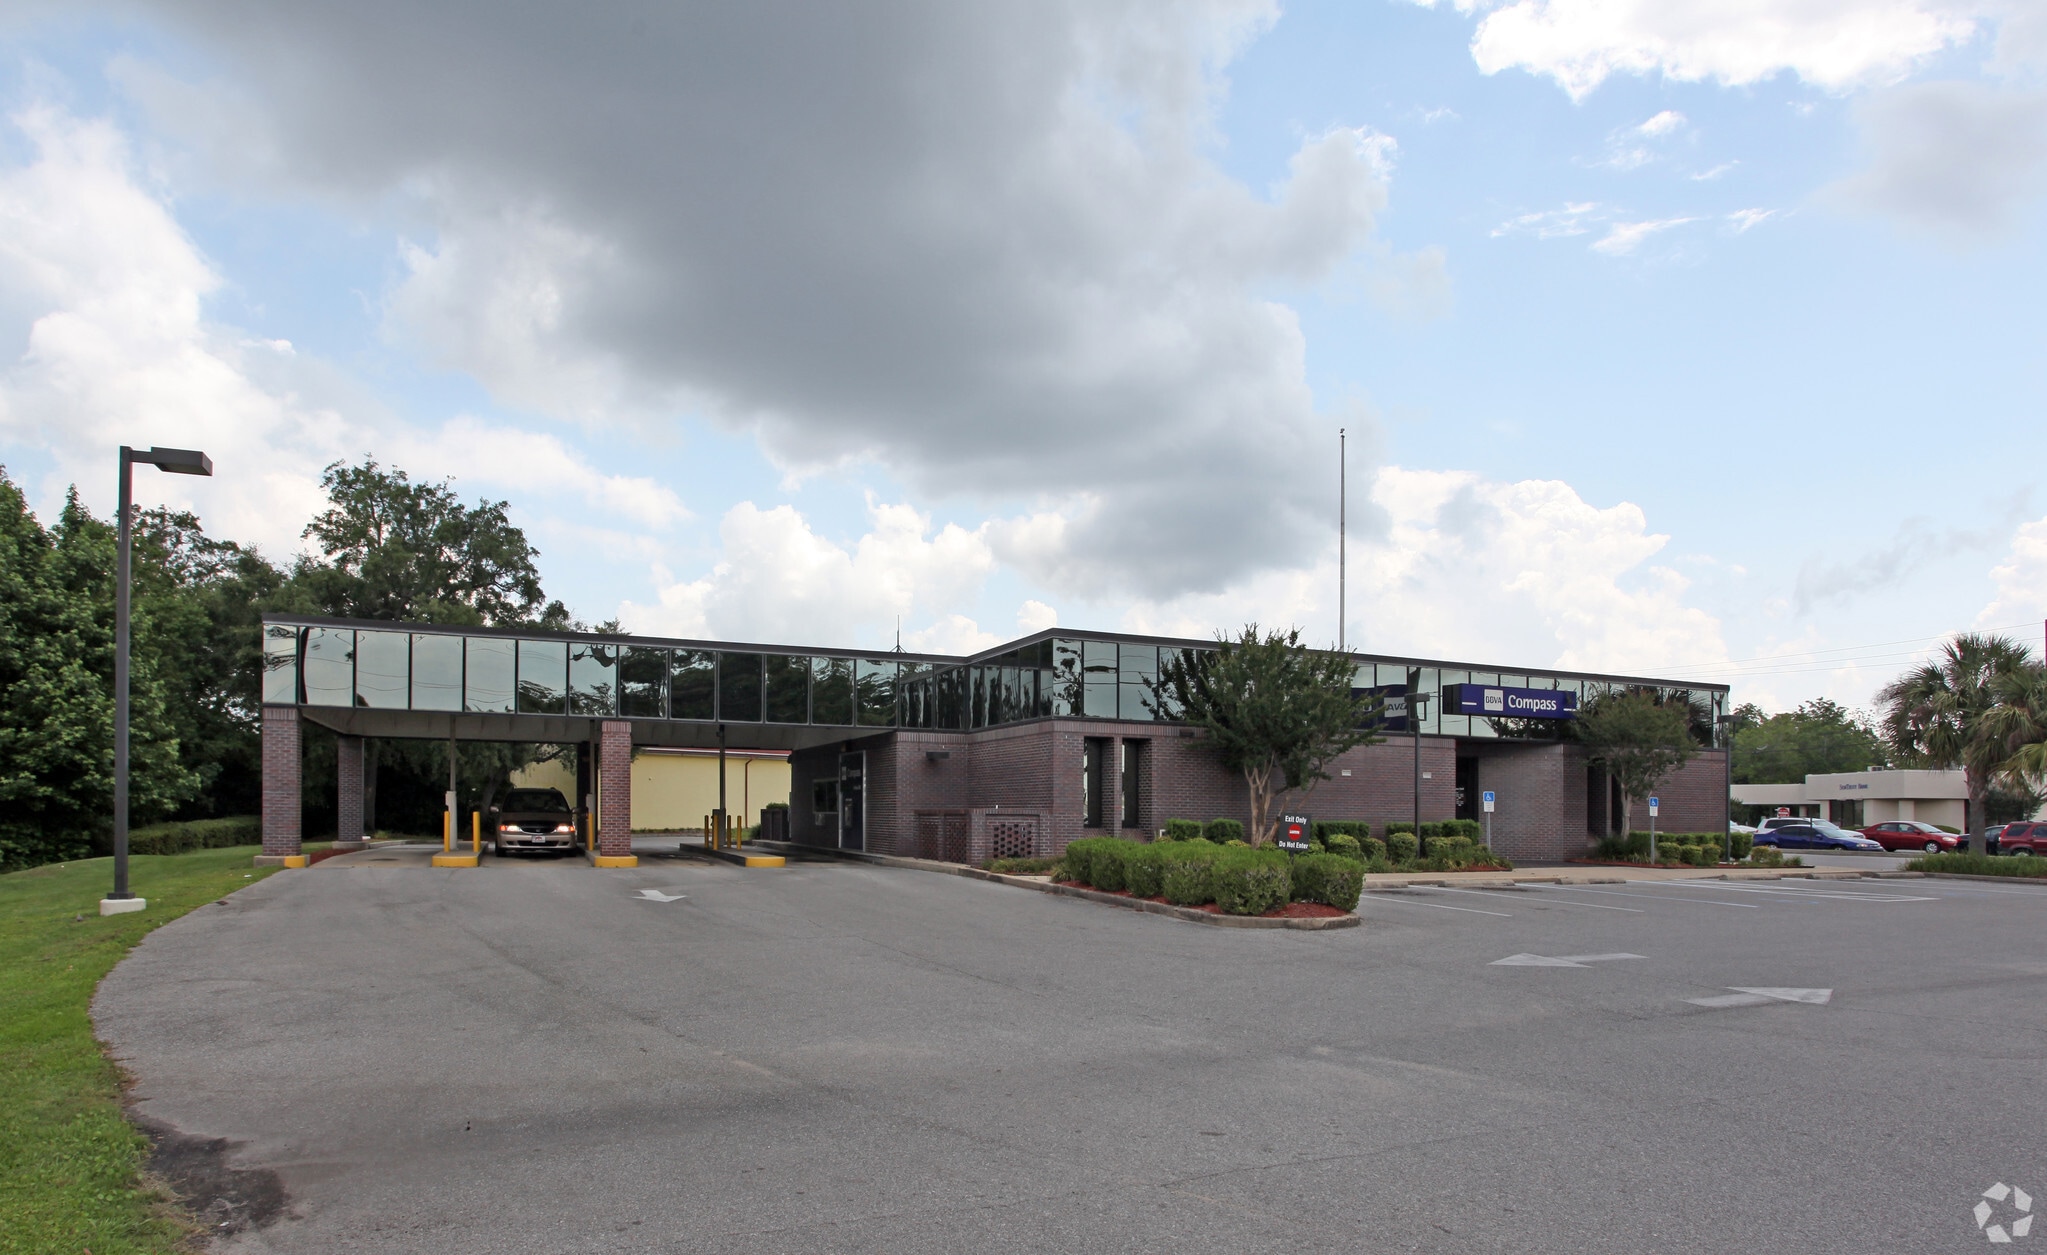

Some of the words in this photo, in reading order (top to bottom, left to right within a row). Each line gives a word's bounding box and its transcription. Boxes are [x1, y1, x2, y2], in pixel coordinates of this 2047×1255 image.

[1485, 695, 1502, 704] BBVA
[1508, 694, 1557, 712] Compass
[1285, 815, 1294, 823] Exit
[1295, 816, 1307, 825] Only
[1287, 841, 1296, 849] Not
[1296, 841, 1309, 849] Enter
